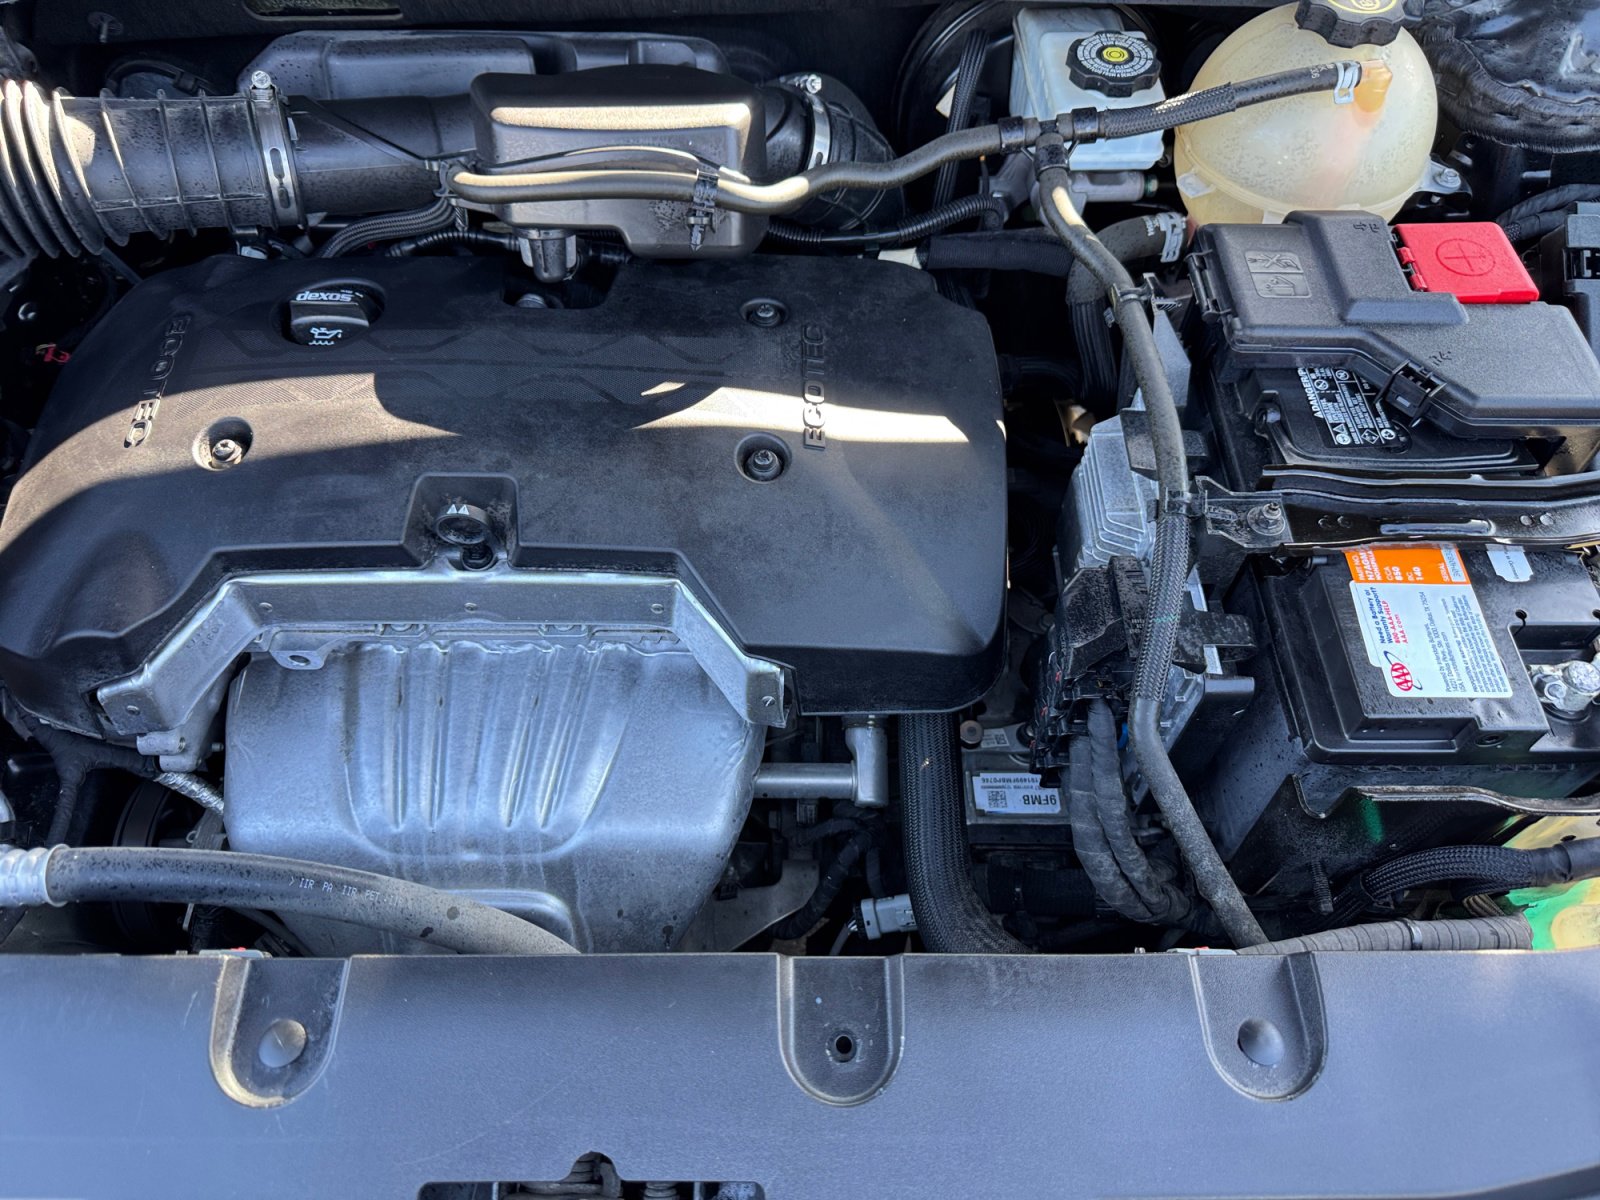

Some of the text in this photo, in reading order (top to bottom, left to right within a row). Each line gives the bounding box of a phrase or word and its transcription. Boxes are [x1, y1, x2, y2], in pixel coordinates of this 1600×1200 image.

[296, 291, 354, 301] dexos
[123, 314, 192, 448] ECOTEC
[801, 323, 827, 451] ECOTEC
[1383, 566, 1393, 580] CCA
[1391, 566, 1403, 580] 850
[1406, 572, 1415, 580] RC
[1412, 566, 1424, 580] 140
[1437, 562, 1450, 581] SERIAL
[1366, 597, 1378, 618] Battery
[1369, 586, 1393, 643] Warranty Support?
[1381, 600, 1401, 643] 800-AAA-HELP
[1393, 614, 1408, 643] AAA.com
[1375, 626, 1385, 643] Need
[1391, 662, 1413, 691] AAA
[1023, 794, 1056, 805] 9FMB
[322, 882, 333, 893] PA
